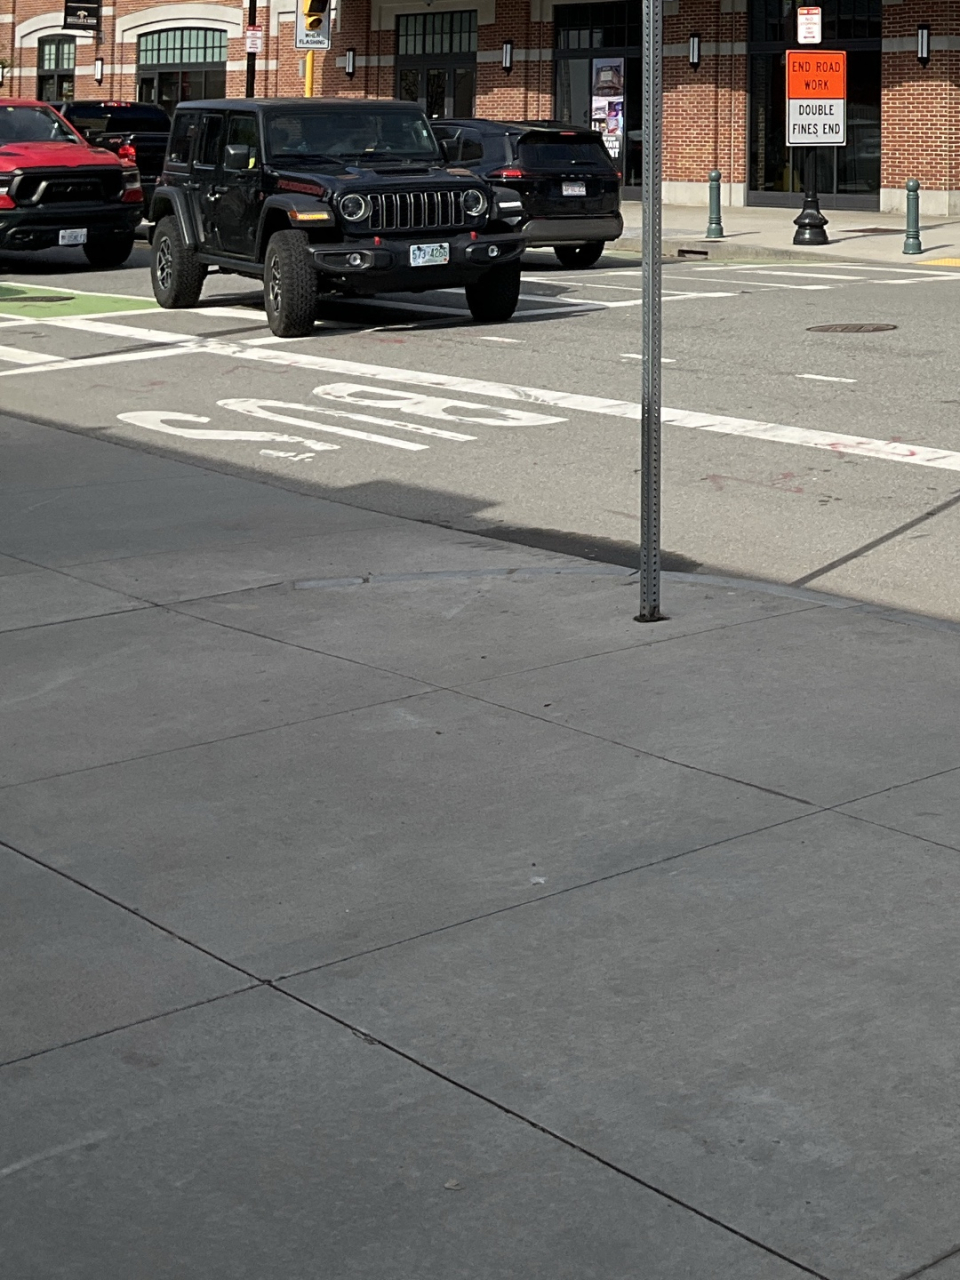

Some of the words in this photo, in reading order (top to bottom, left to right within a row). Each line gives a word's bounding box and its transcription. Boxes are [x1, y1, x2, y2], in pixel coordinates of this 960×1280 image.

[792, 61, 811, 72] END
[816, 61, 841, 73] ROAD
[804, 79, 829, 90] WORK
[799, 105, 835, 116] DOUBLE
[792, 123, 818, 135] FINES
[822, 123, 841, 134] END
